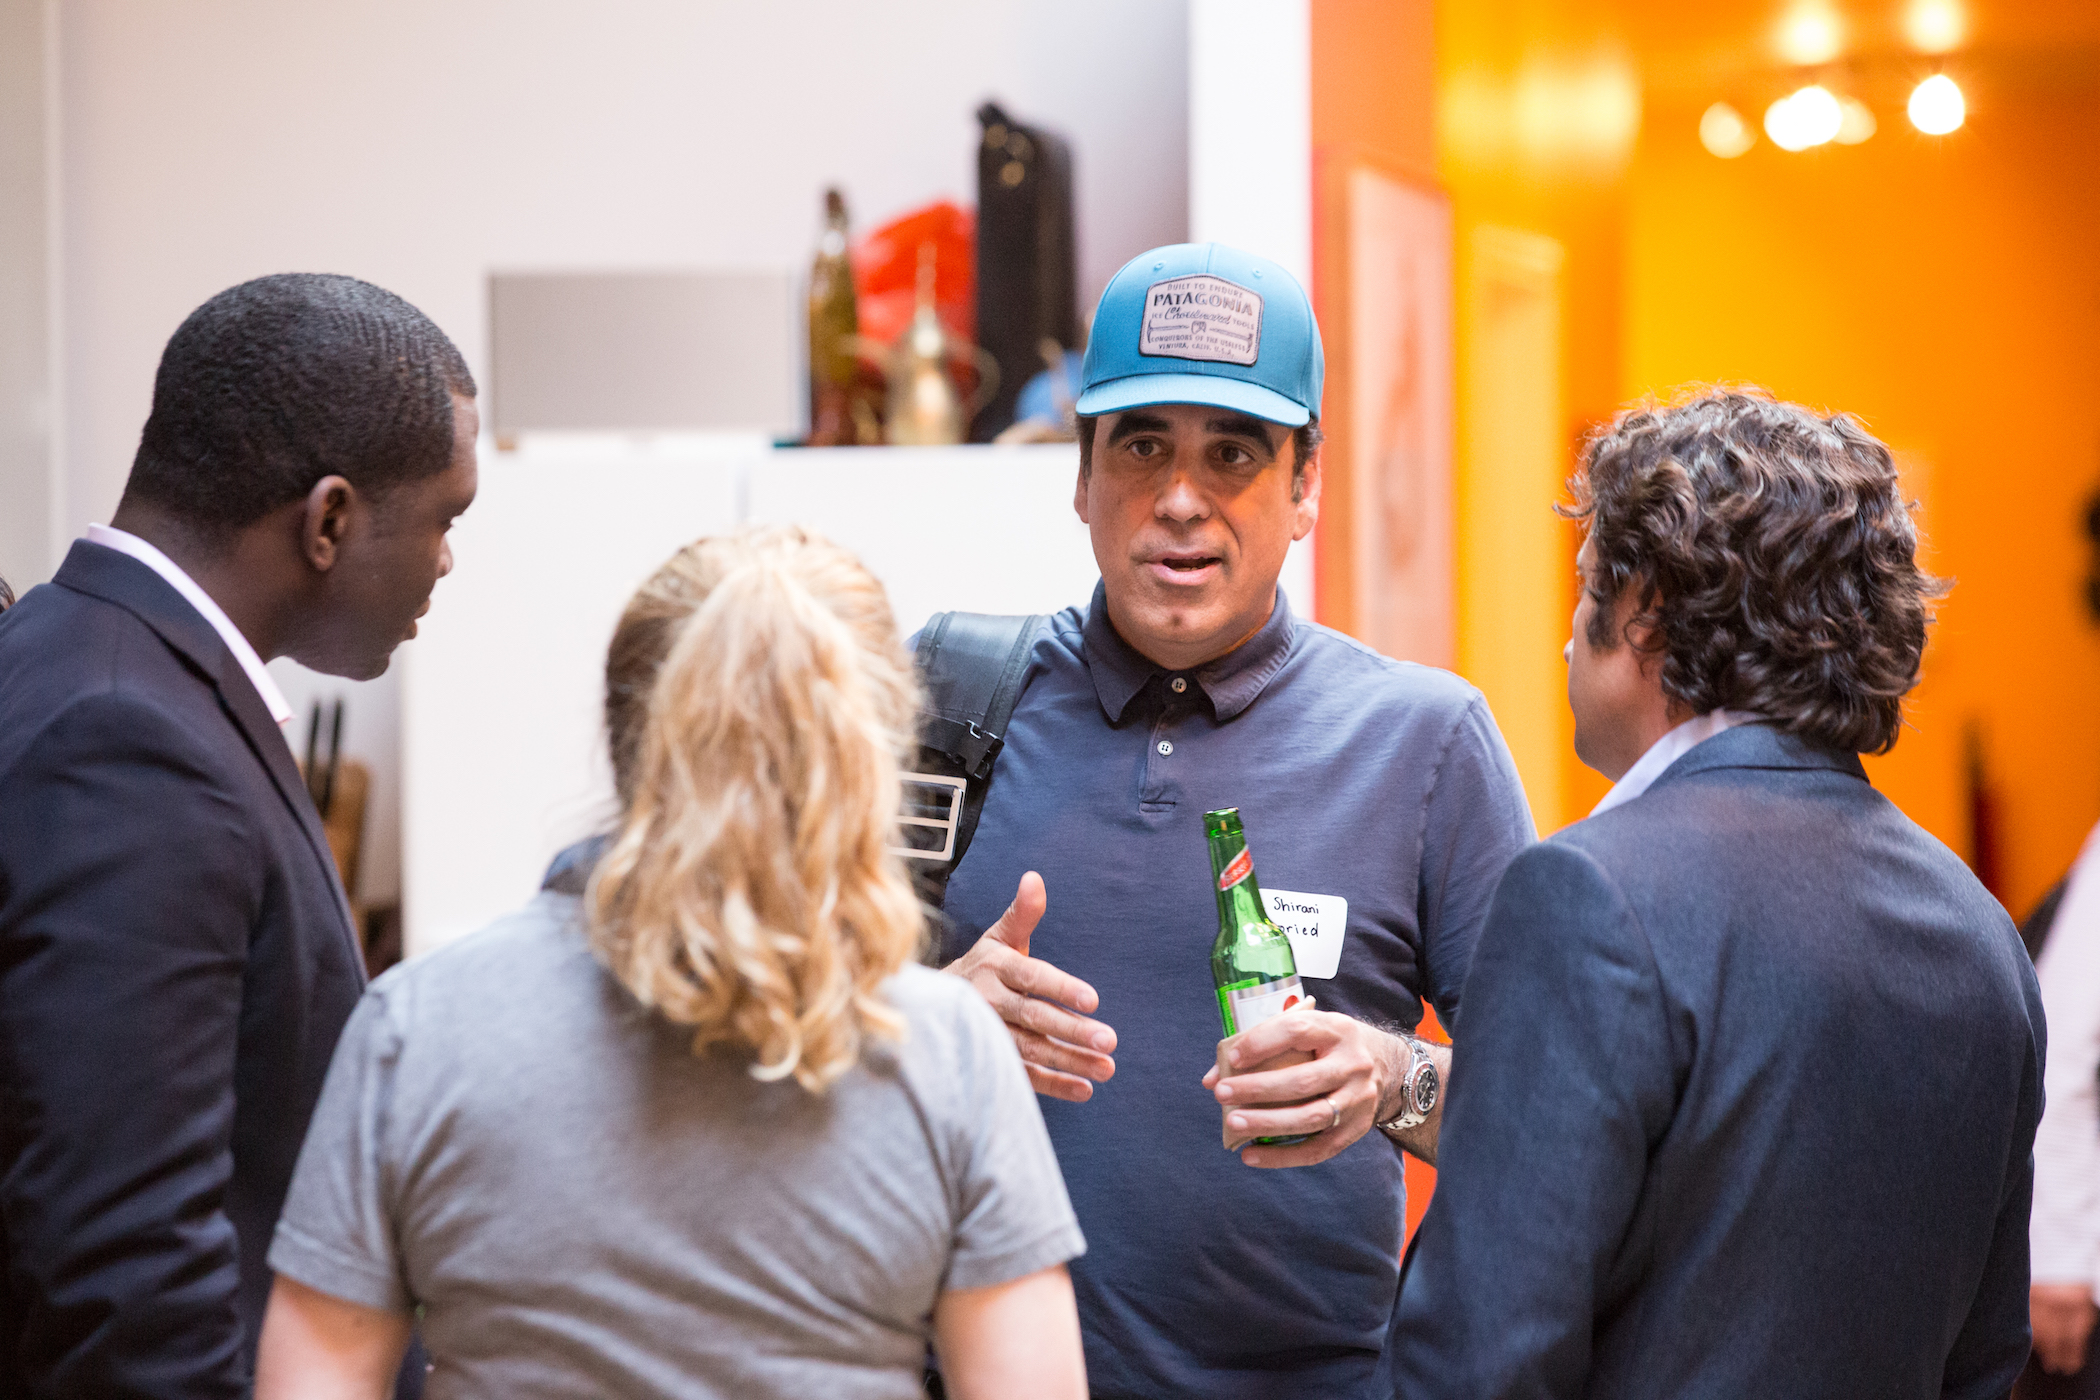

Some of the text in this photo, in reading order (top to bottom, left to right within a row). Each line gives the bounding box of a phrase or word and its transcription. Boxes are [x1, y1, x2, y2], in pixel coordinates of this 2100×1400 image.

[1167, 282, 1190, 291] BUILT
[1209, 284, 1243, 298] ENDURE
[1153, 292, 1253, 316] PATAGONIA
[1232, 318, 1255, 330] TOOLS
[1206, 336, 1218, 344] THE
[1220, 339, 1246, 352] USELESS
[1273, 896, 1319, 914] Shirani
